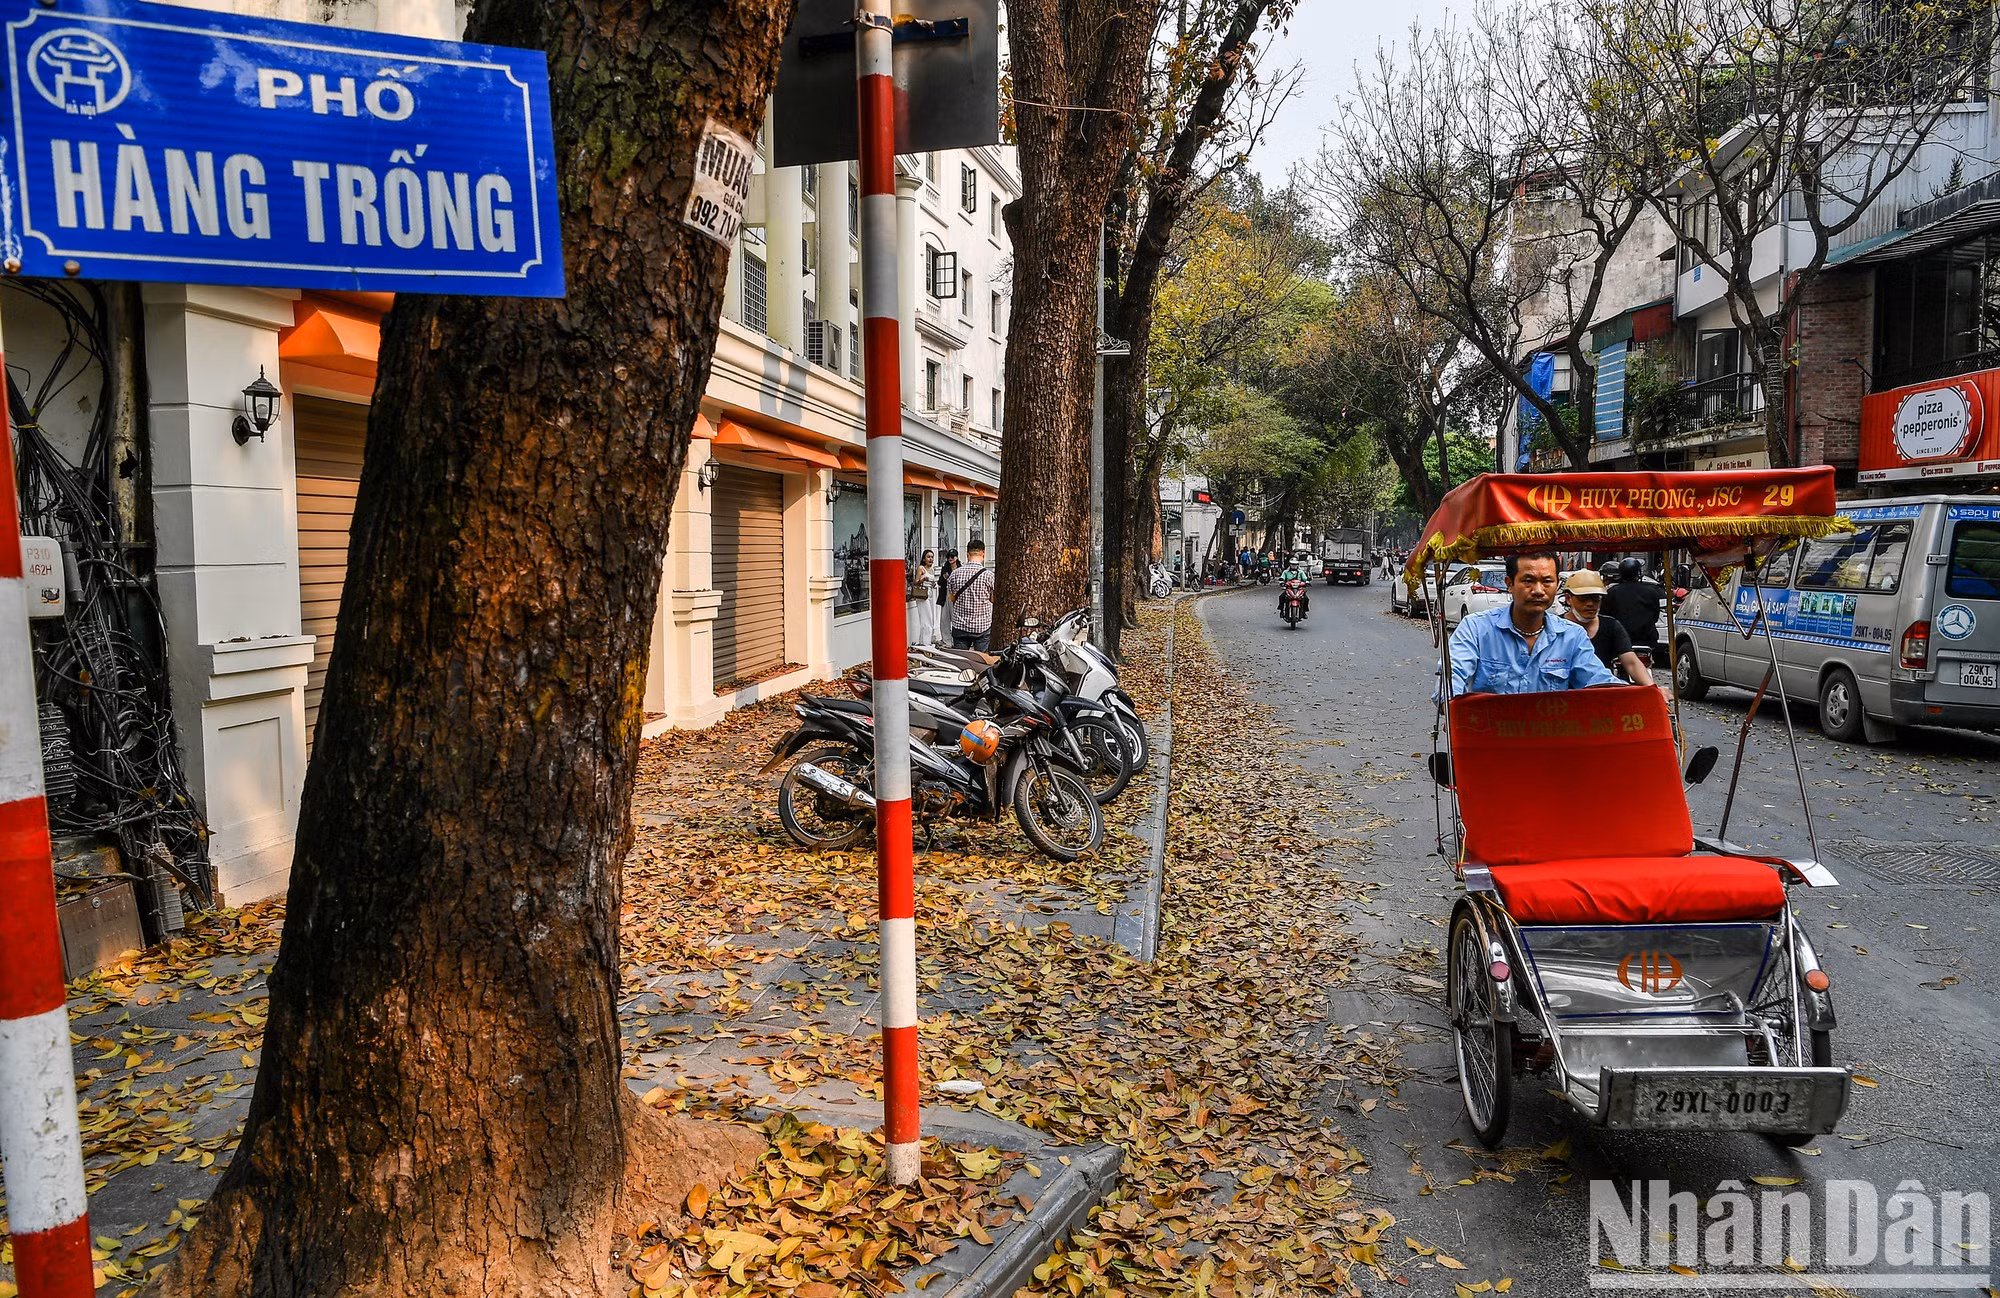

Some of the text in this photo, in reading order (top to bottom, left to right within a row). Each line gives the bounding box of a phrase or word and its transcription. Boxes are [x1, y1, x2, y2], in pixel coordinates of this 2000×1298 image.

[258, 66, 418, 121] PHỐ
[66, 99, 96, 120] HÀ NỘI
[50, 123, 517, 253] HÀNG TRỐNG
[690, 195, 719, 230] 092
[1918, 400, 1943, 420] pizza
[1902, 413, 1958, 439] pepperonis
[1579, 488, 1625, 509] HUY
[1706, 486, 1743, 508] JSC
[1763, 485, 1794, 506] 29
[1960, 509, 1989, 518] sapy
[29, 564, 52, 576] 462H
[1854, 625, 1868, 638] 29KT
[1968, 664, 1990, 676] 29KT
[1963, 675, 1993, 686] 004.95
[1621, 714, 1644, 731] 29
[1654, 1090, 1791, 1114] 29XL-0003
